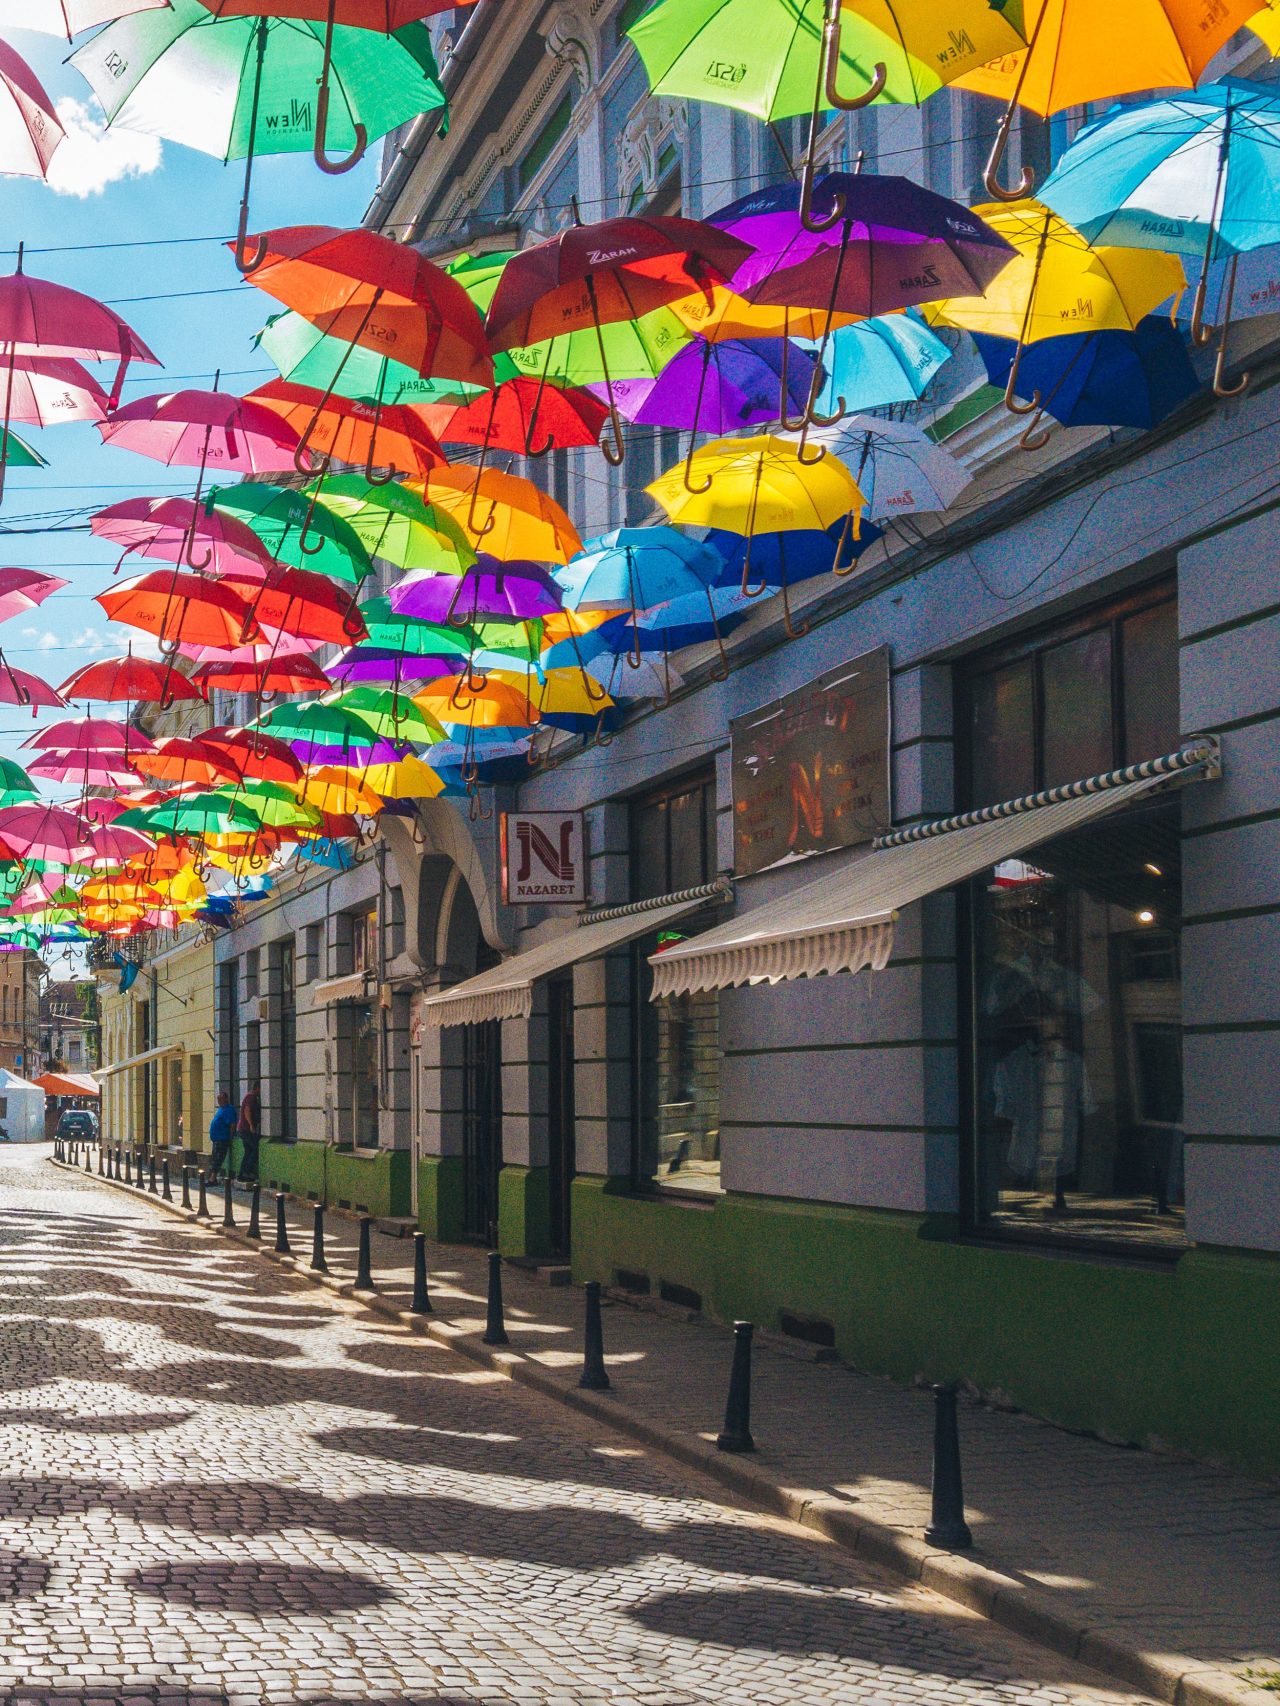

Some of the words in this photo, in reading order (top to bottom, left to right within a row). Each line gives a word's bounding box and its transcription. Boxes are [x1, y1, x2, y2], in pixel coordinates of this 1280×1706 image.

[585, 246, 637, 266] ZARAH
[516, 821, 575, 882] N
[517, 885, 576, 896] NAZARET
